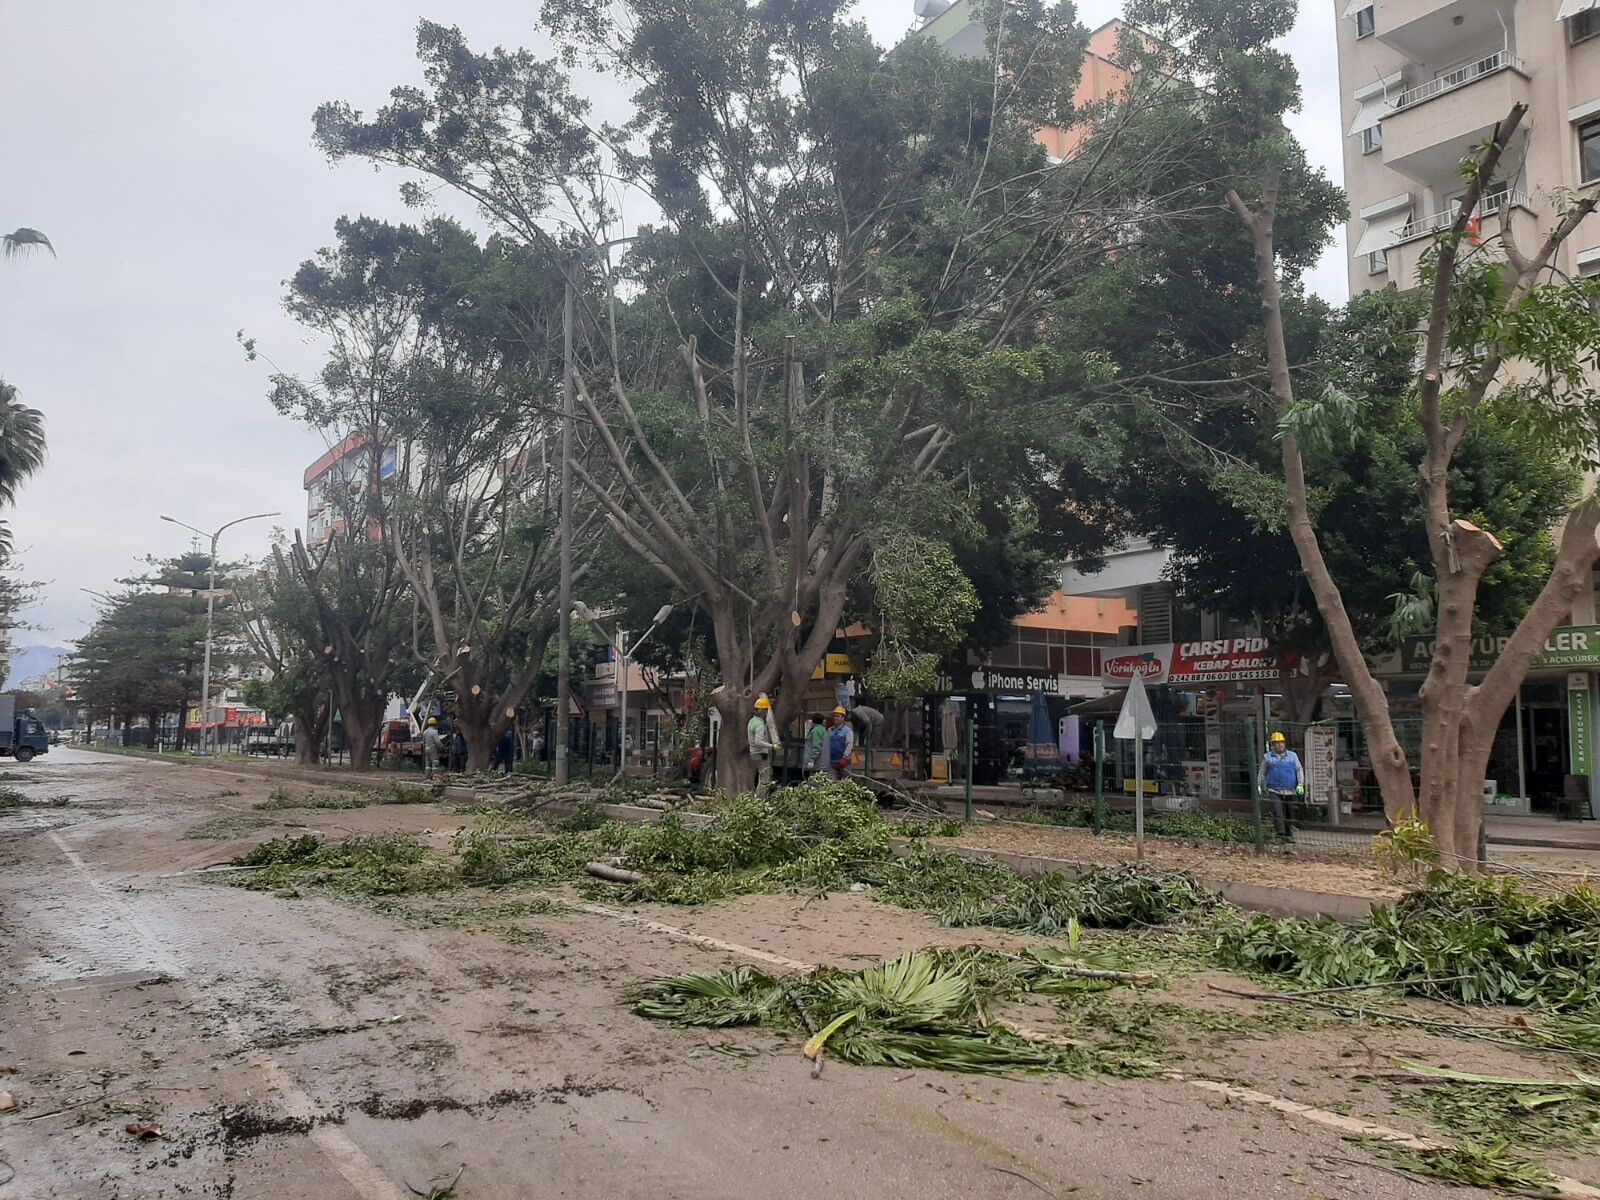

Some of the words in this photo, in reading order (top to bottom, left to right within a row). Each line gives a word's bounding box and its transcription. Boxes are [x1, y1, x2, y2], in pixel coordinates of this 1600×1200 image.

[1180, 640, 1228, 661] ÇARŞI
[1106, 660, 1160, 677] Yörükoğlu
[1193, 660, 1229, 671] KEBAP
[988, 671, 1024, 689] iPhone
[1026, 675, 1058, 691] Servis
